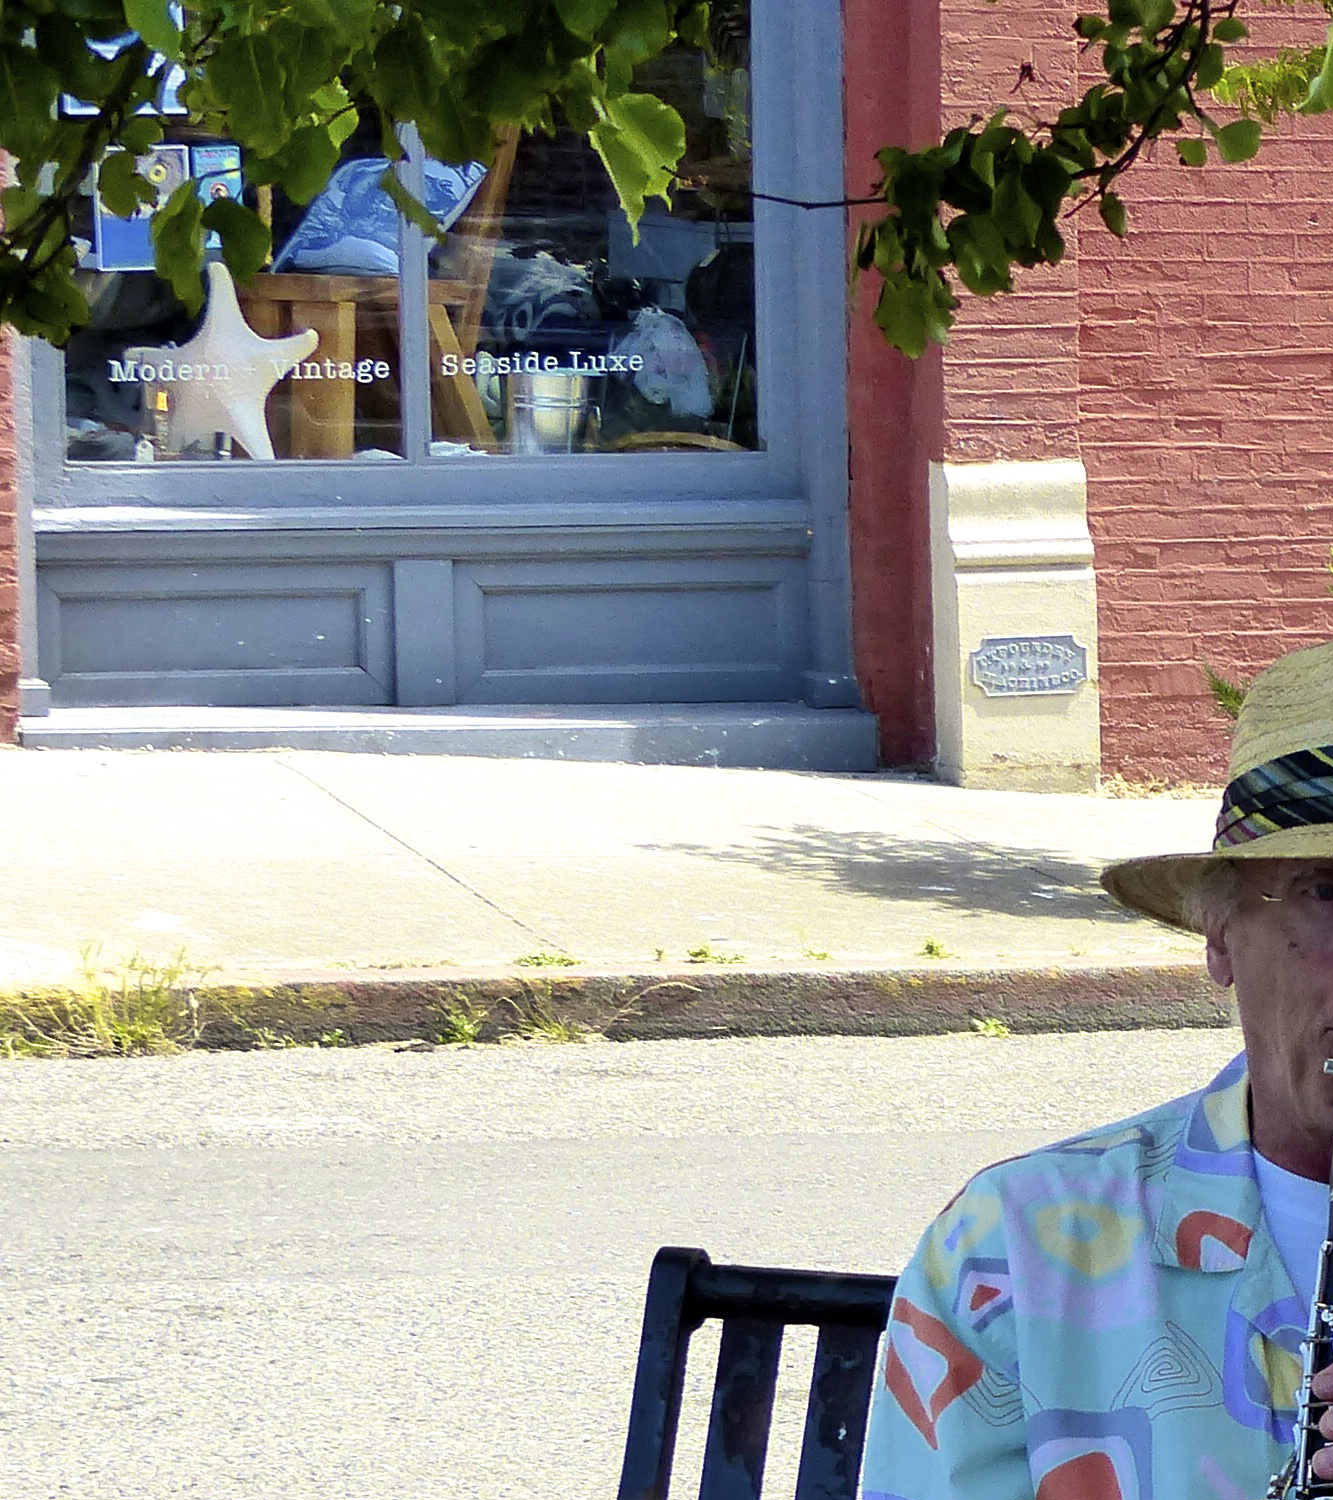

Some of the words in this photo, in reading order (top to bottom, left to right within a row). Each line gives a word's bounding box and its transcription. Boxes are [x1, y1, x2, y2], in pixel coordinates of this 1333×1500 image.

[107, 358, 232, 383] Modern
[272, 358, 391, 384] Vintage
[442, 351, 560, 376] Seaside
[569, 350, 645, 373] Luxe
